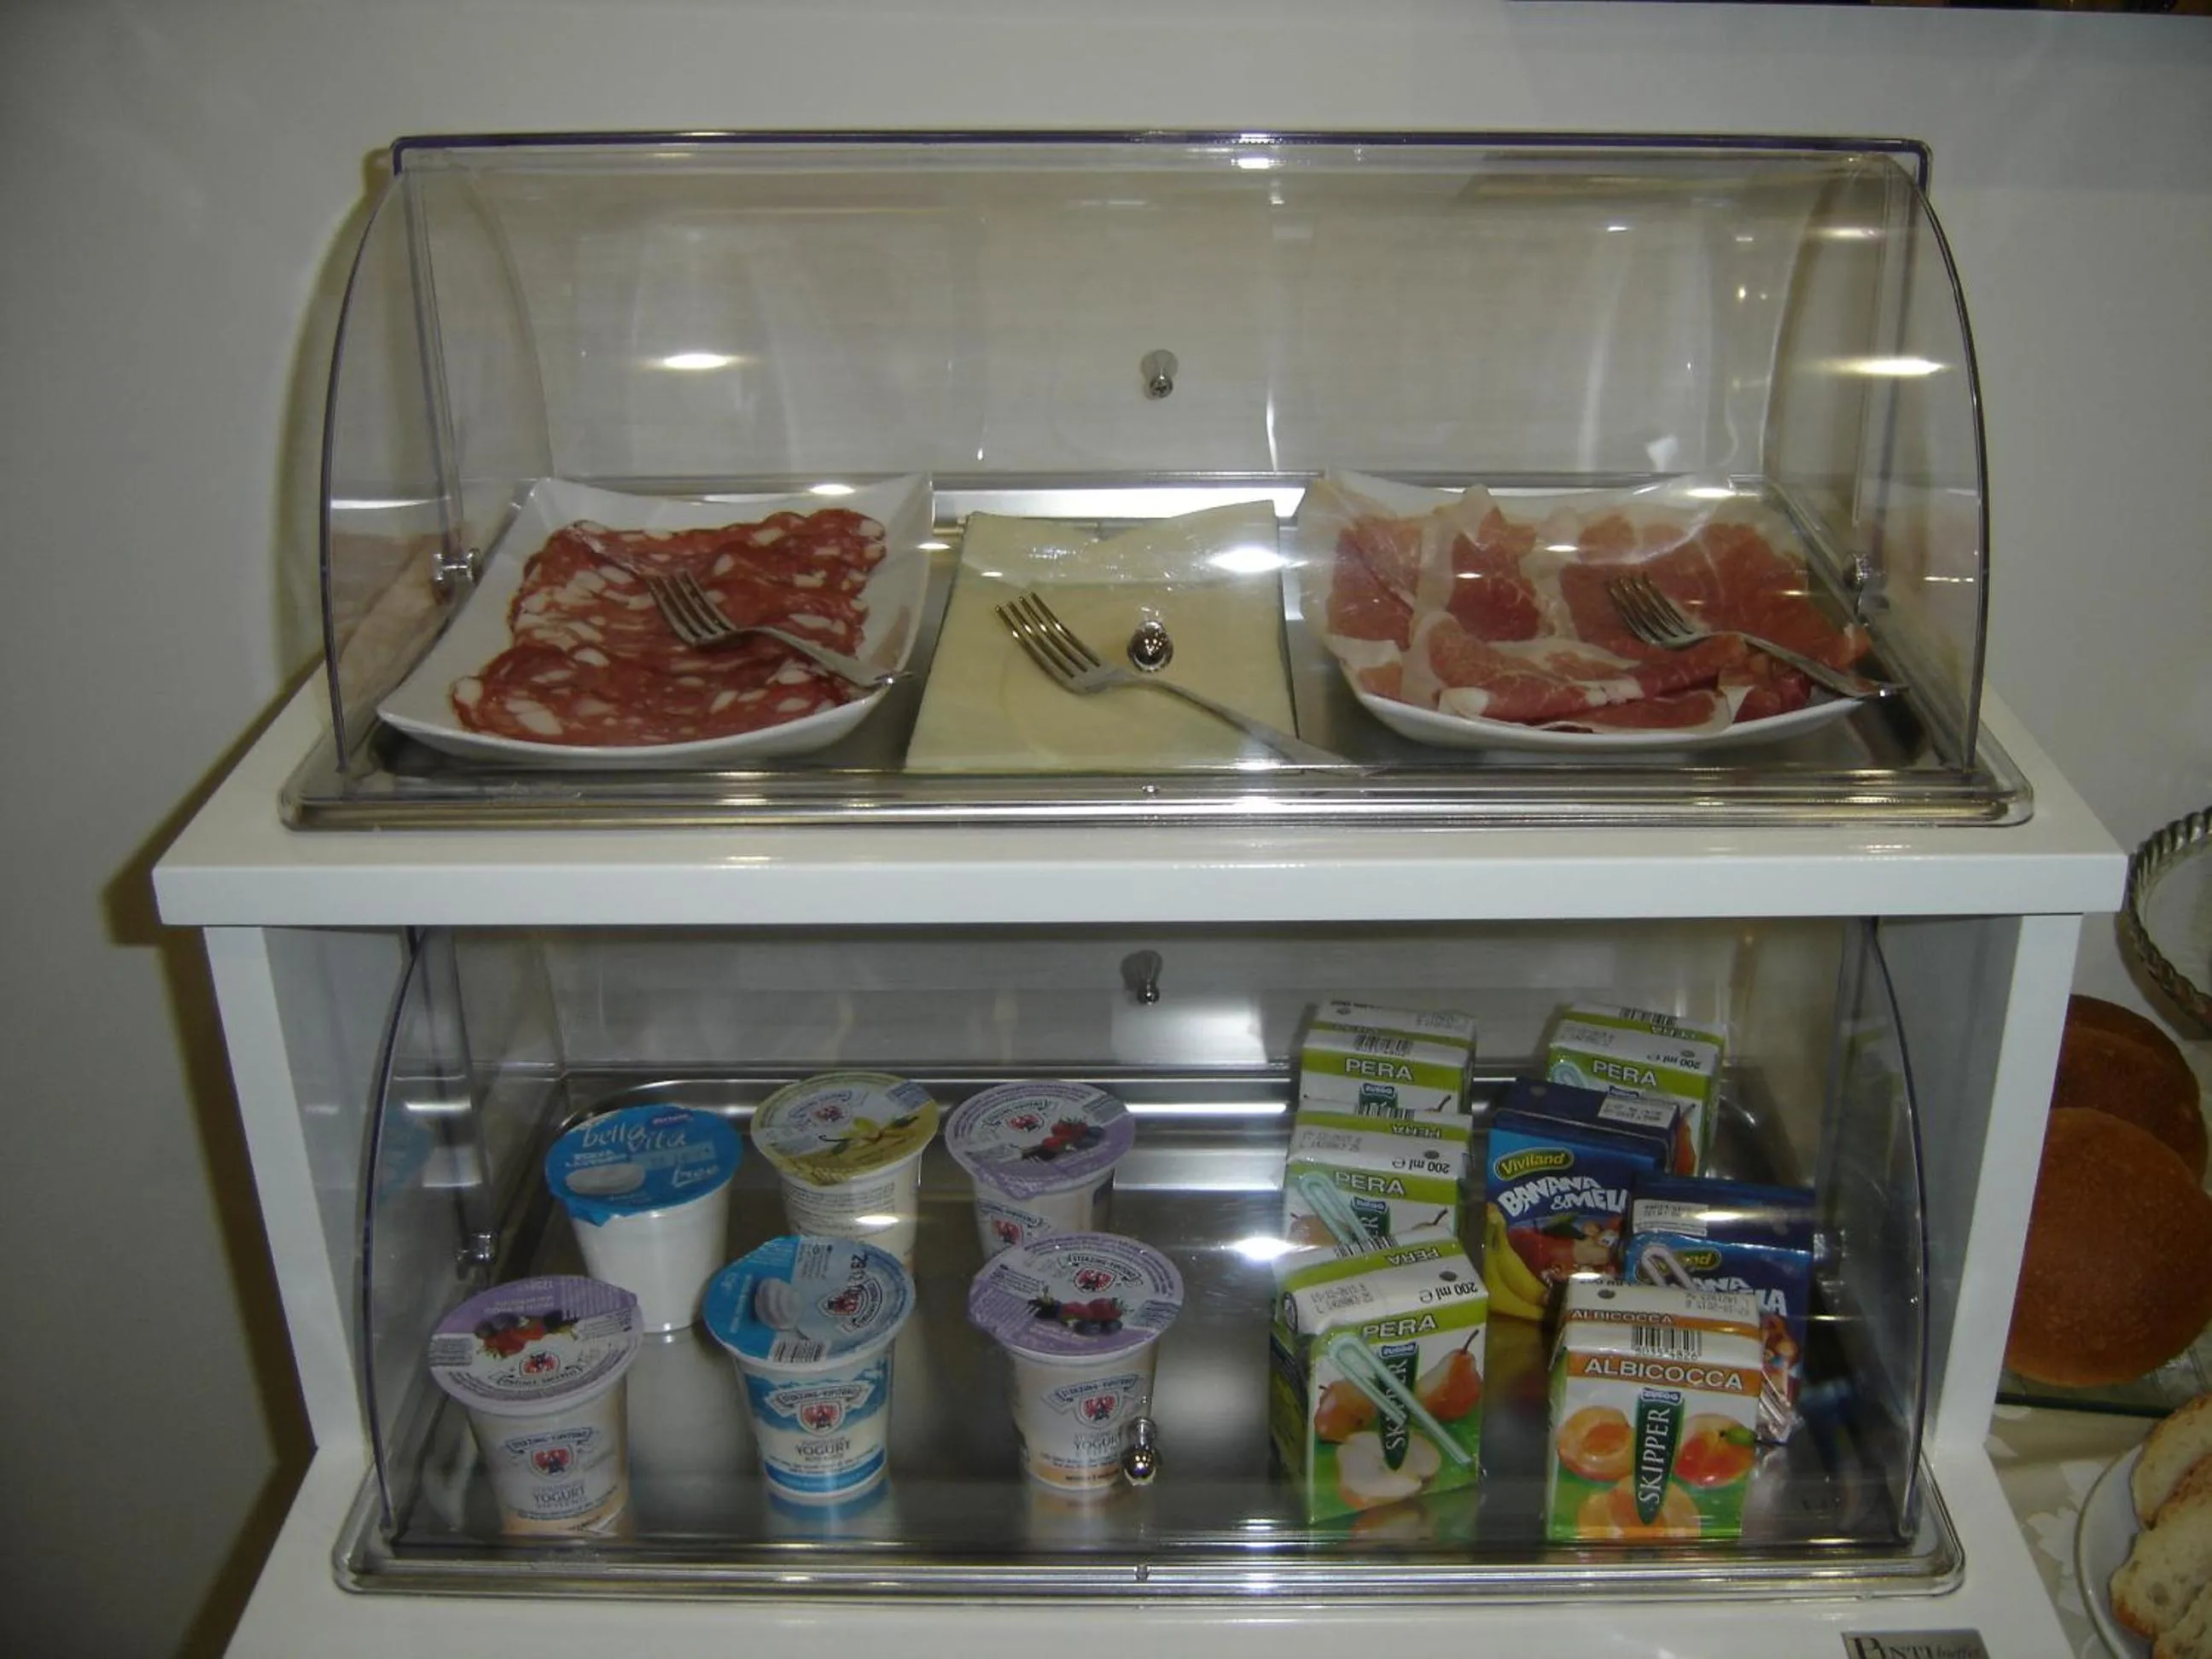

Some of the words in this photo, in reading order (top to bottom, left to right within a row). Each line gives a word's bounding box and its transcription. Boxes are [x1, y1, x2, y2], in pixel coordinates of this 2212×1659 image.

[1346, 1058, 1413, 1080] PERA
[1592, 1060, 1656, 1086] PERA
[1409, 1159, 1424, 1170] ml
[1428, 1162, 1450, 1174] 200
[1500, 1154, 1565, 1175] Viviland
[1335, 1171, 1405, 1194] PERA
[1498, 1176, 1602, 1217] BANANA
[1388, 1246, 1441, 1266] PERA
[1435, 1285, 1452, 1300] ml
[1453, 1282, 1478, 1296] 200
[1363, 1313, 1437, 1337] PERA
[1585, 1357, 1743, 1390] ALBICOCCA
[795, 1439, 851, 1456] YOGURT
[1638, 1407, 1670, 1505] SKIPPER
[533, 1485, 585, 1505] YOGURT
